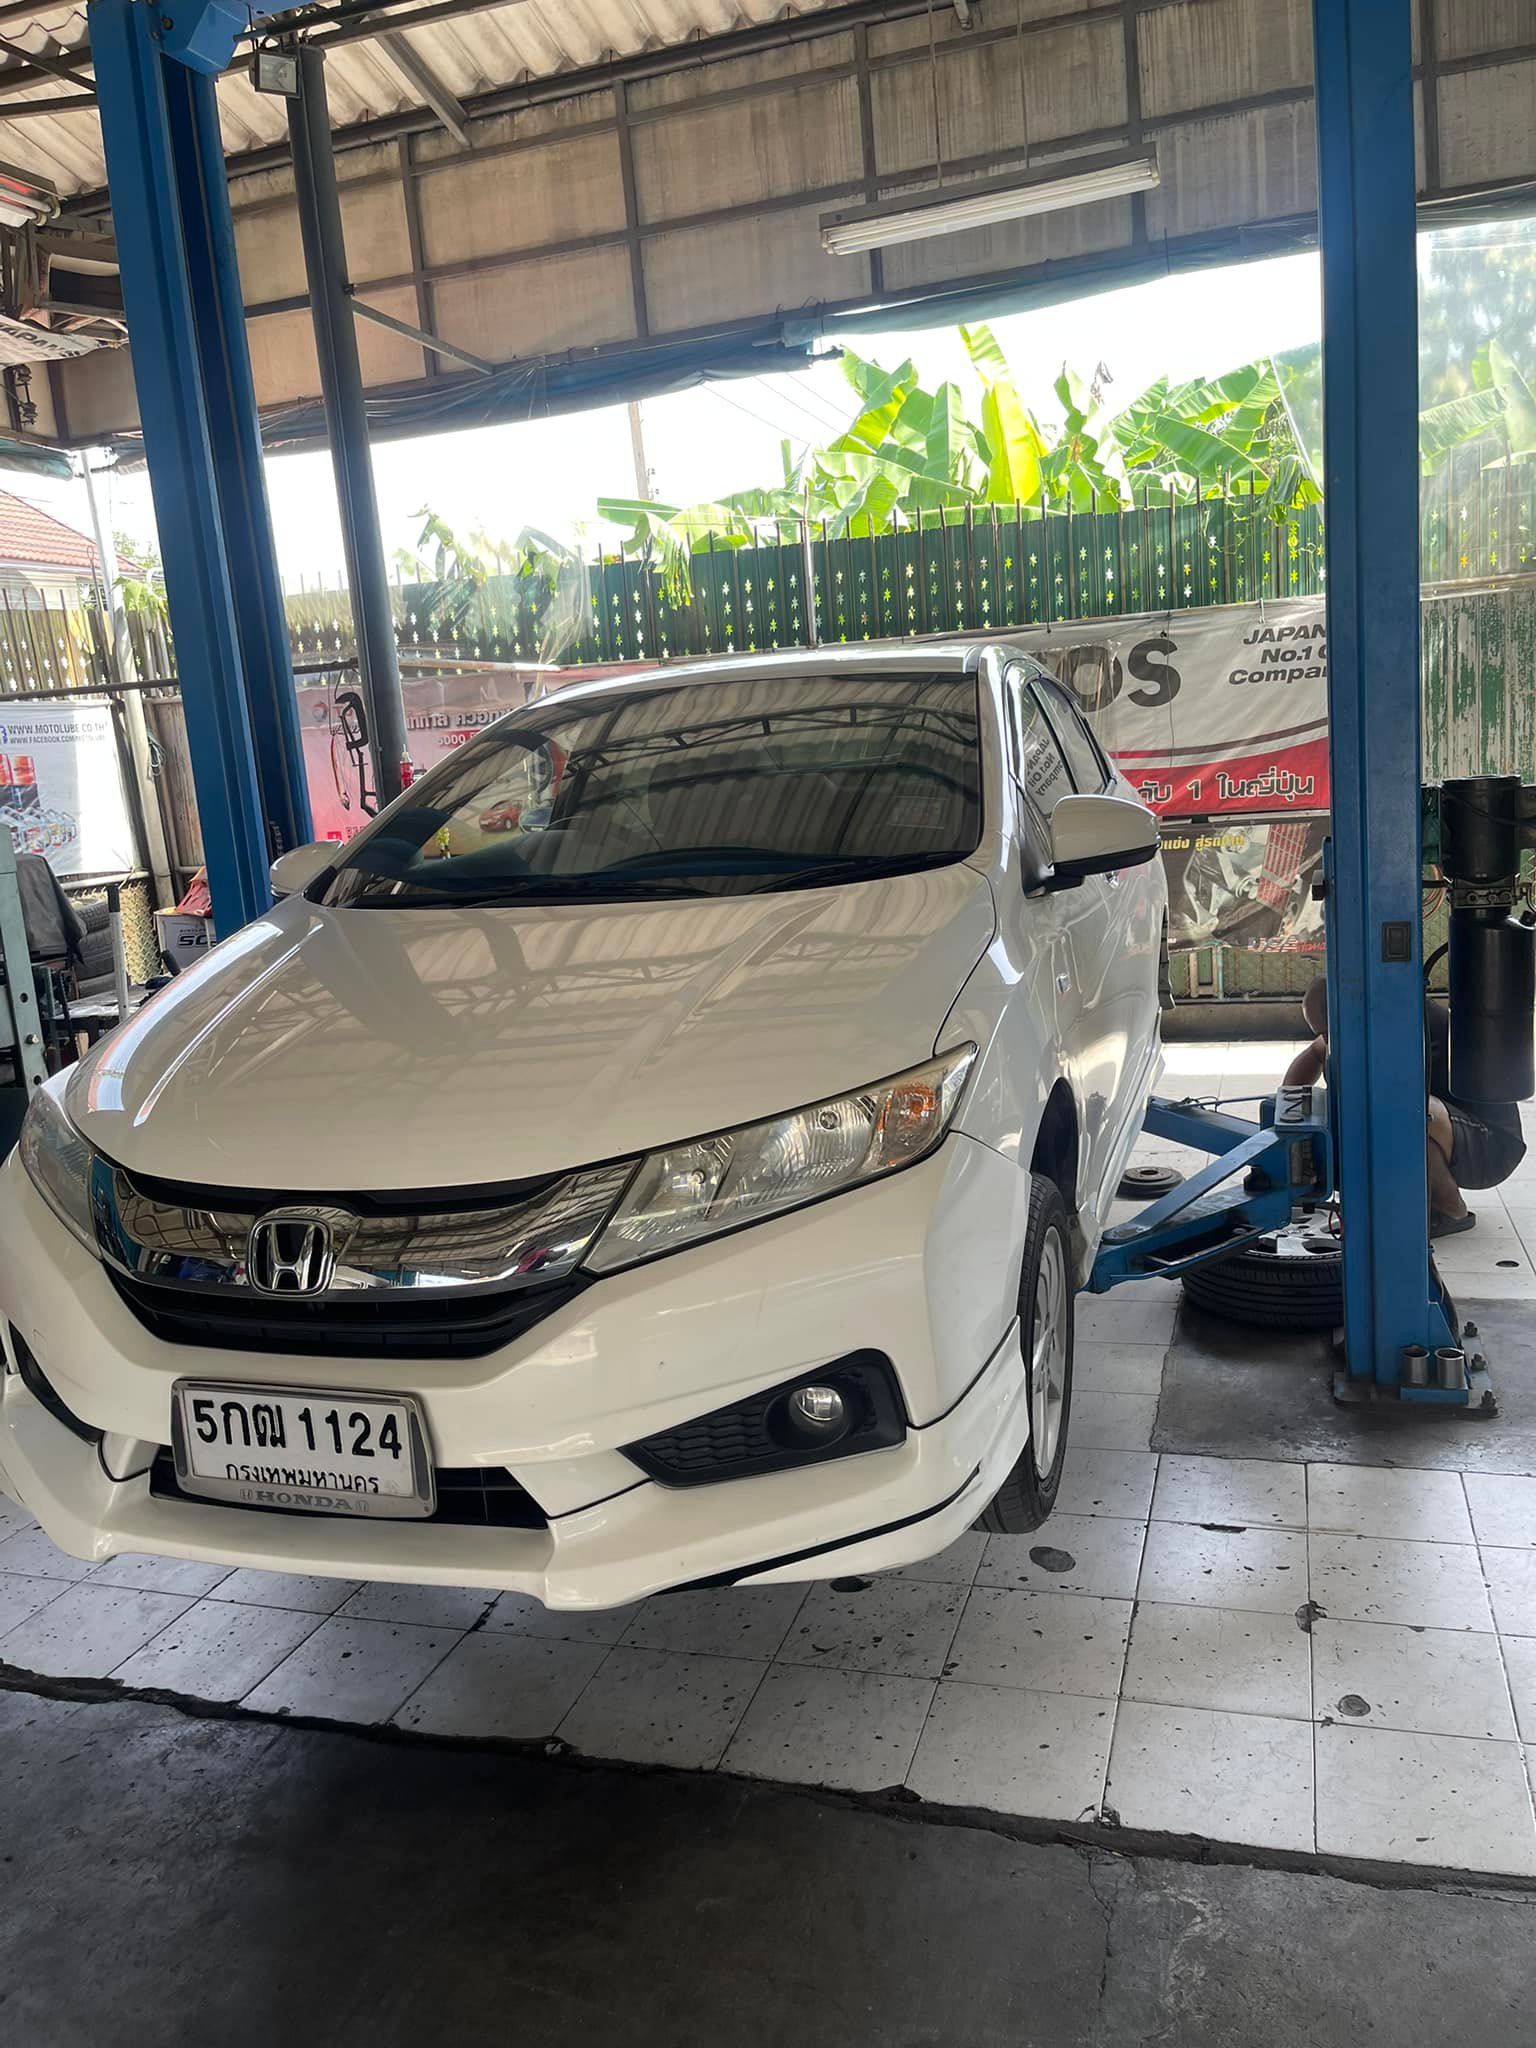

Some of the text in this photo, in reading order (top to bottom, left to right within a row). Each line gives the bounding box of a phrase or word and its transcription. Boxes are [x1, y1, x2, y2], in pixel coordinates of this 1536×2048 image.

[1261, 645, 1313, 664] No.1
[1056, 638, 1181, 713] OS
[1229, 665, 1327, 685] Compa
[1187, 778, 1202, 801] 1
[1216, 766, 1314, 803] ในญี่ปุ่น
[298, 1407, 403, 1460] 1124
[225, 1463, 379, 1494] กรงเทพมหานคร
[256, 1490, 353, 1512] HONDA
